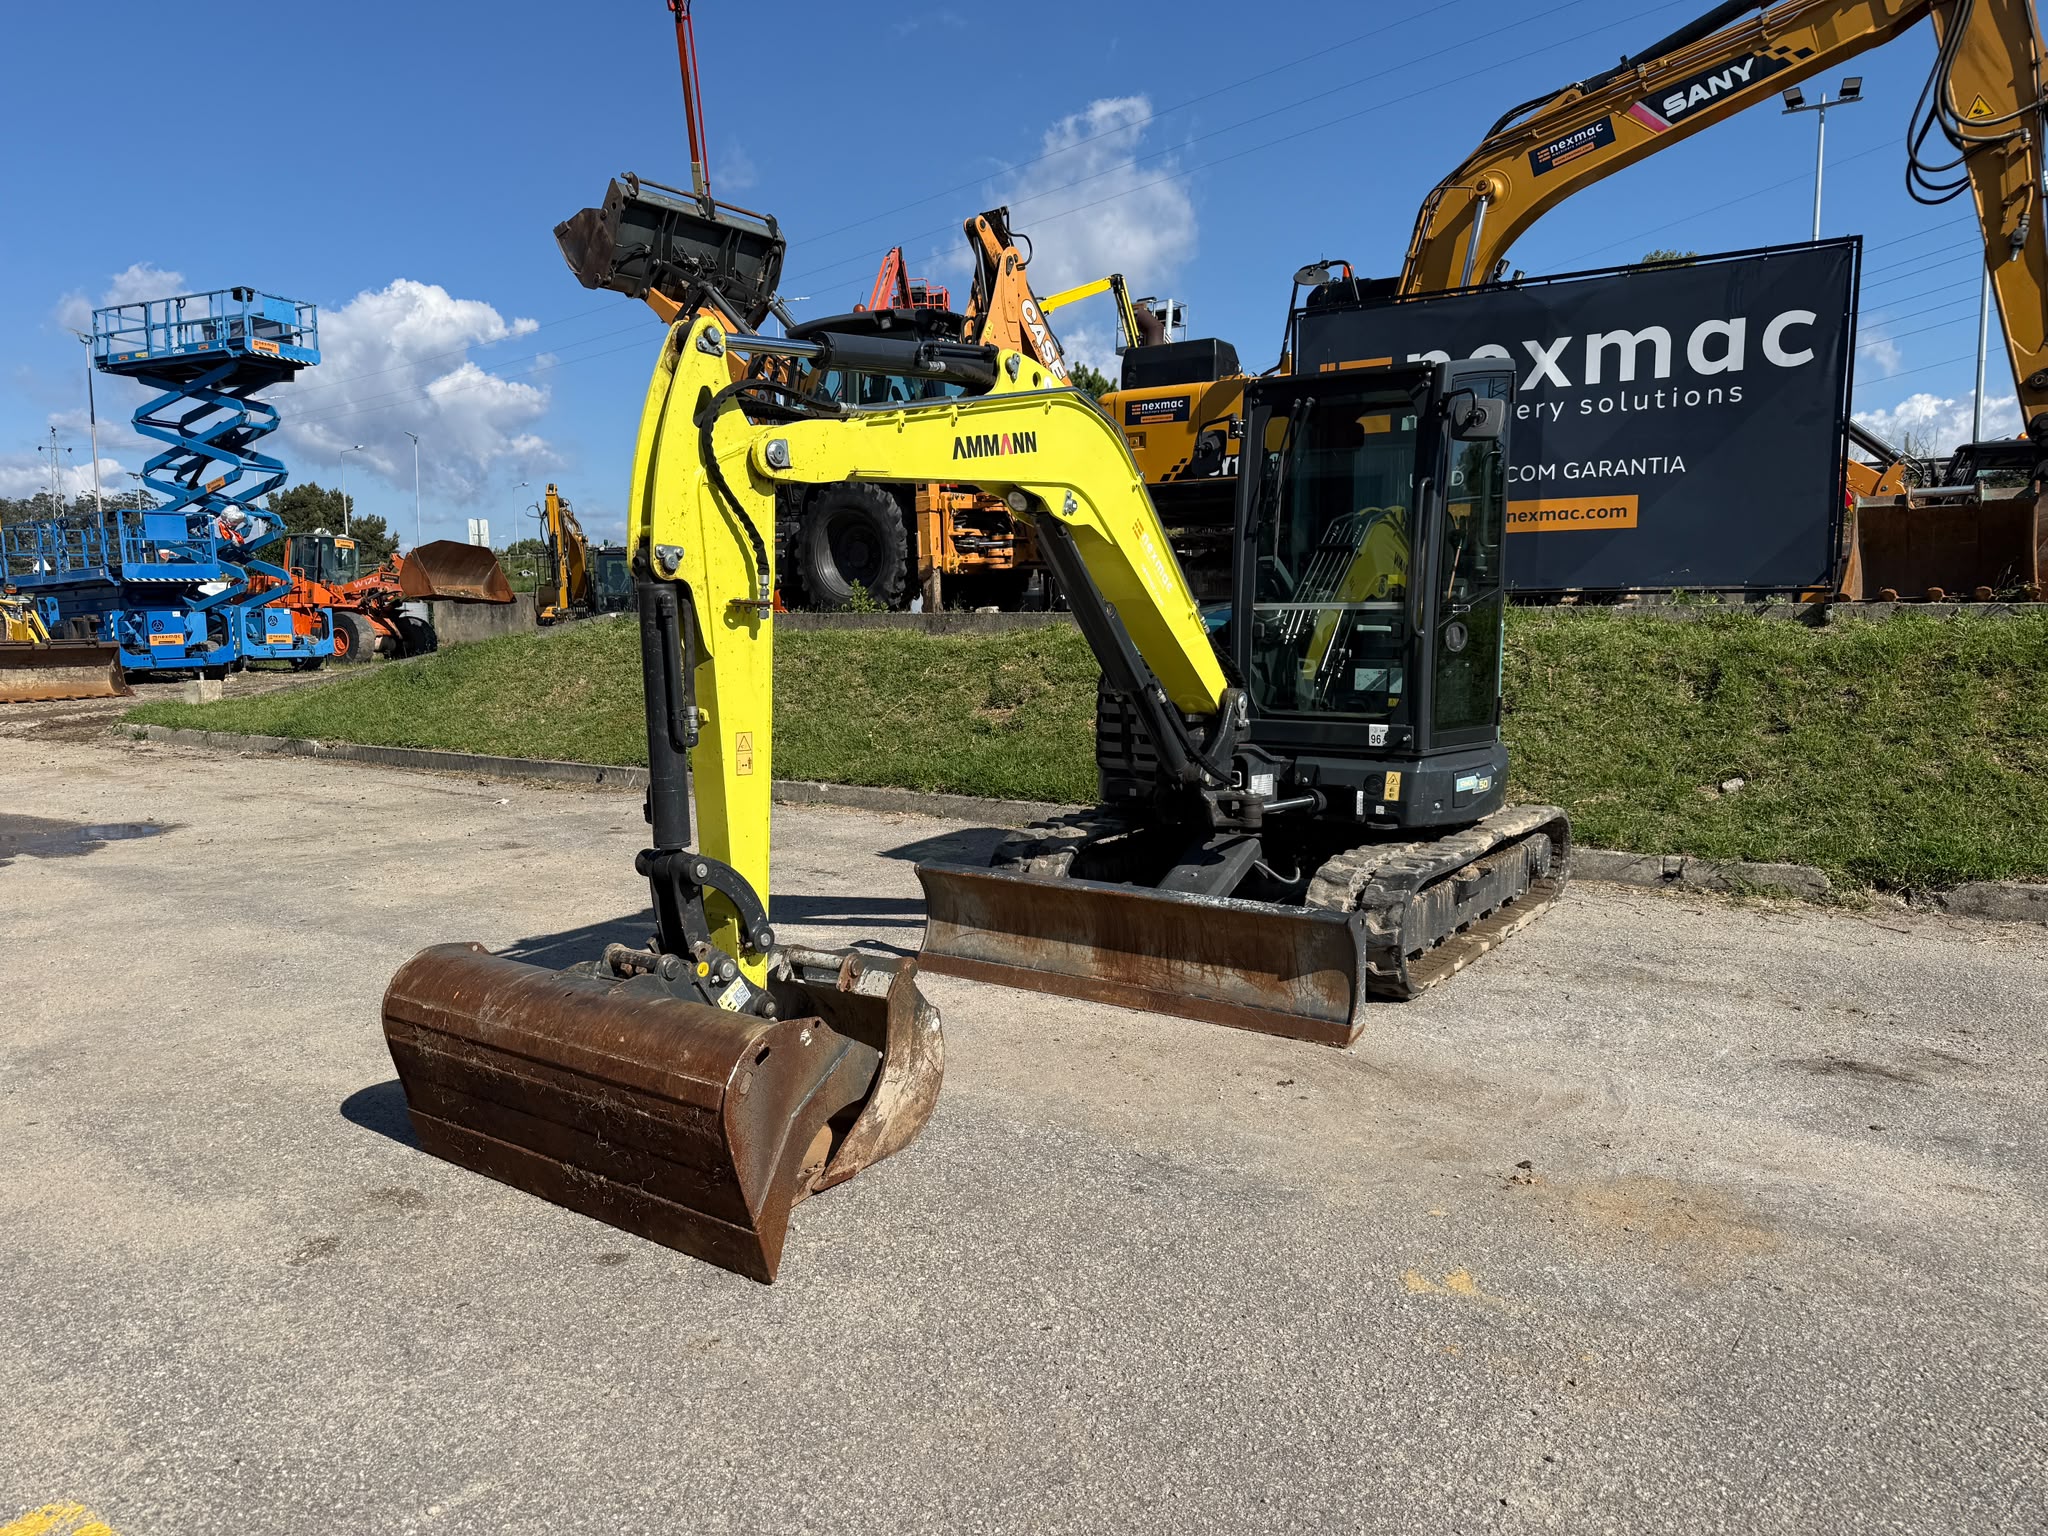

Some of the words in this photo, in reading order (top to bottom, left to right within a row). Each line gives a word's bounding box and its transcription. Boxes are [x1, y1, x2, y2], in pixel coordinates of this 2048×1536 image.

[1663, 57, 1755, 118] SANY
[1549, 123, 1604, 154] nexmac
[1021, 298, 1066, 380] CASE
[1406, 309, 1817, 392] xmac
[1141, 400, 1184, 411] nexmac
[1579, 386, 1743, 415] solutions
[952, 431, 1037, 460] AMMANN
[1508, 463, 1556, 483] COM
[1563, 455, 1686, 480] GARANTIA
[1506, 506, 1628, 523] nexmac.com
[352, 575, 379, 588] W170
[1478, 779, 1488, 790] 50
